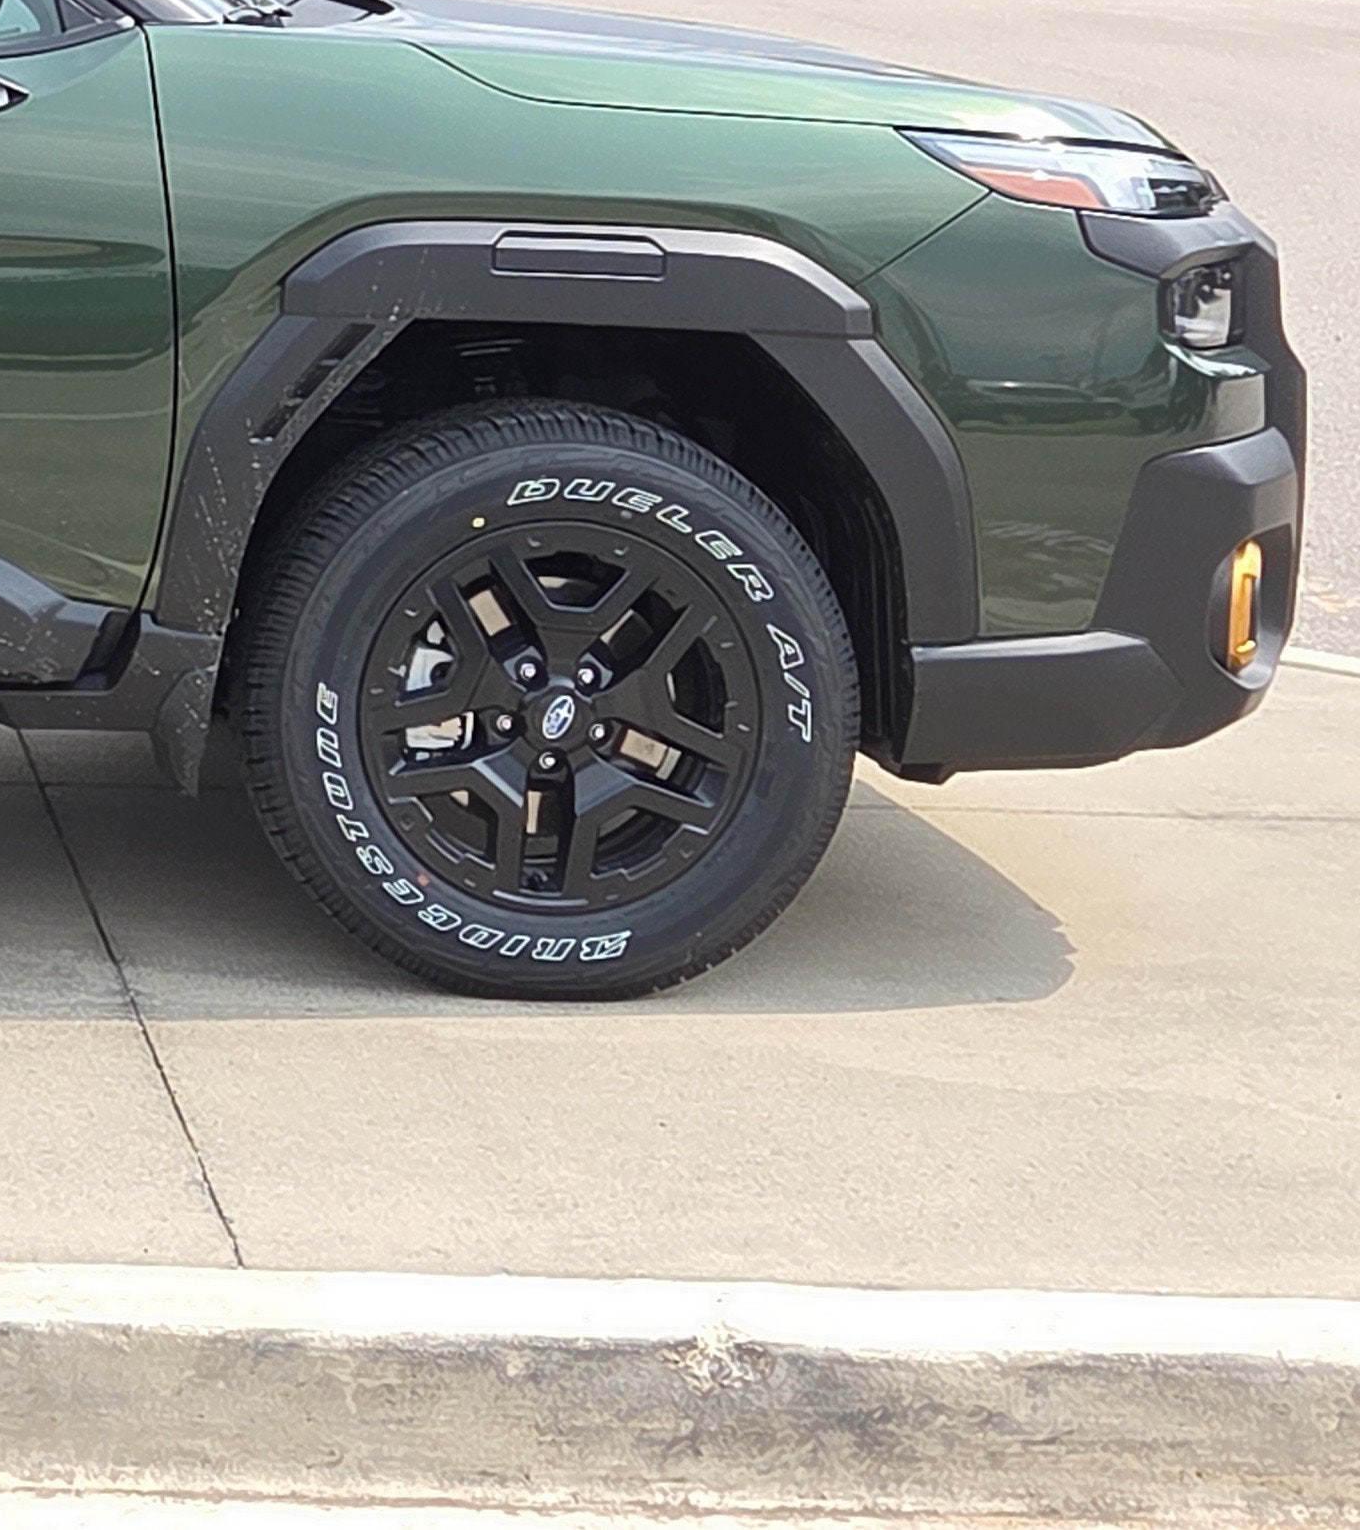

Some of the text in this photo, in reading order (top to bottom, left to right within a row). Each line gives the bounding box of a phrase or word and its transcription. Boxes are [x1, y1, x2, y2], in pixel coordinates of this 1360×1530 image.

[507, 478, 813, 743] DUELER A/T
[316, 682, 632, 961] BRIDGESTONE
